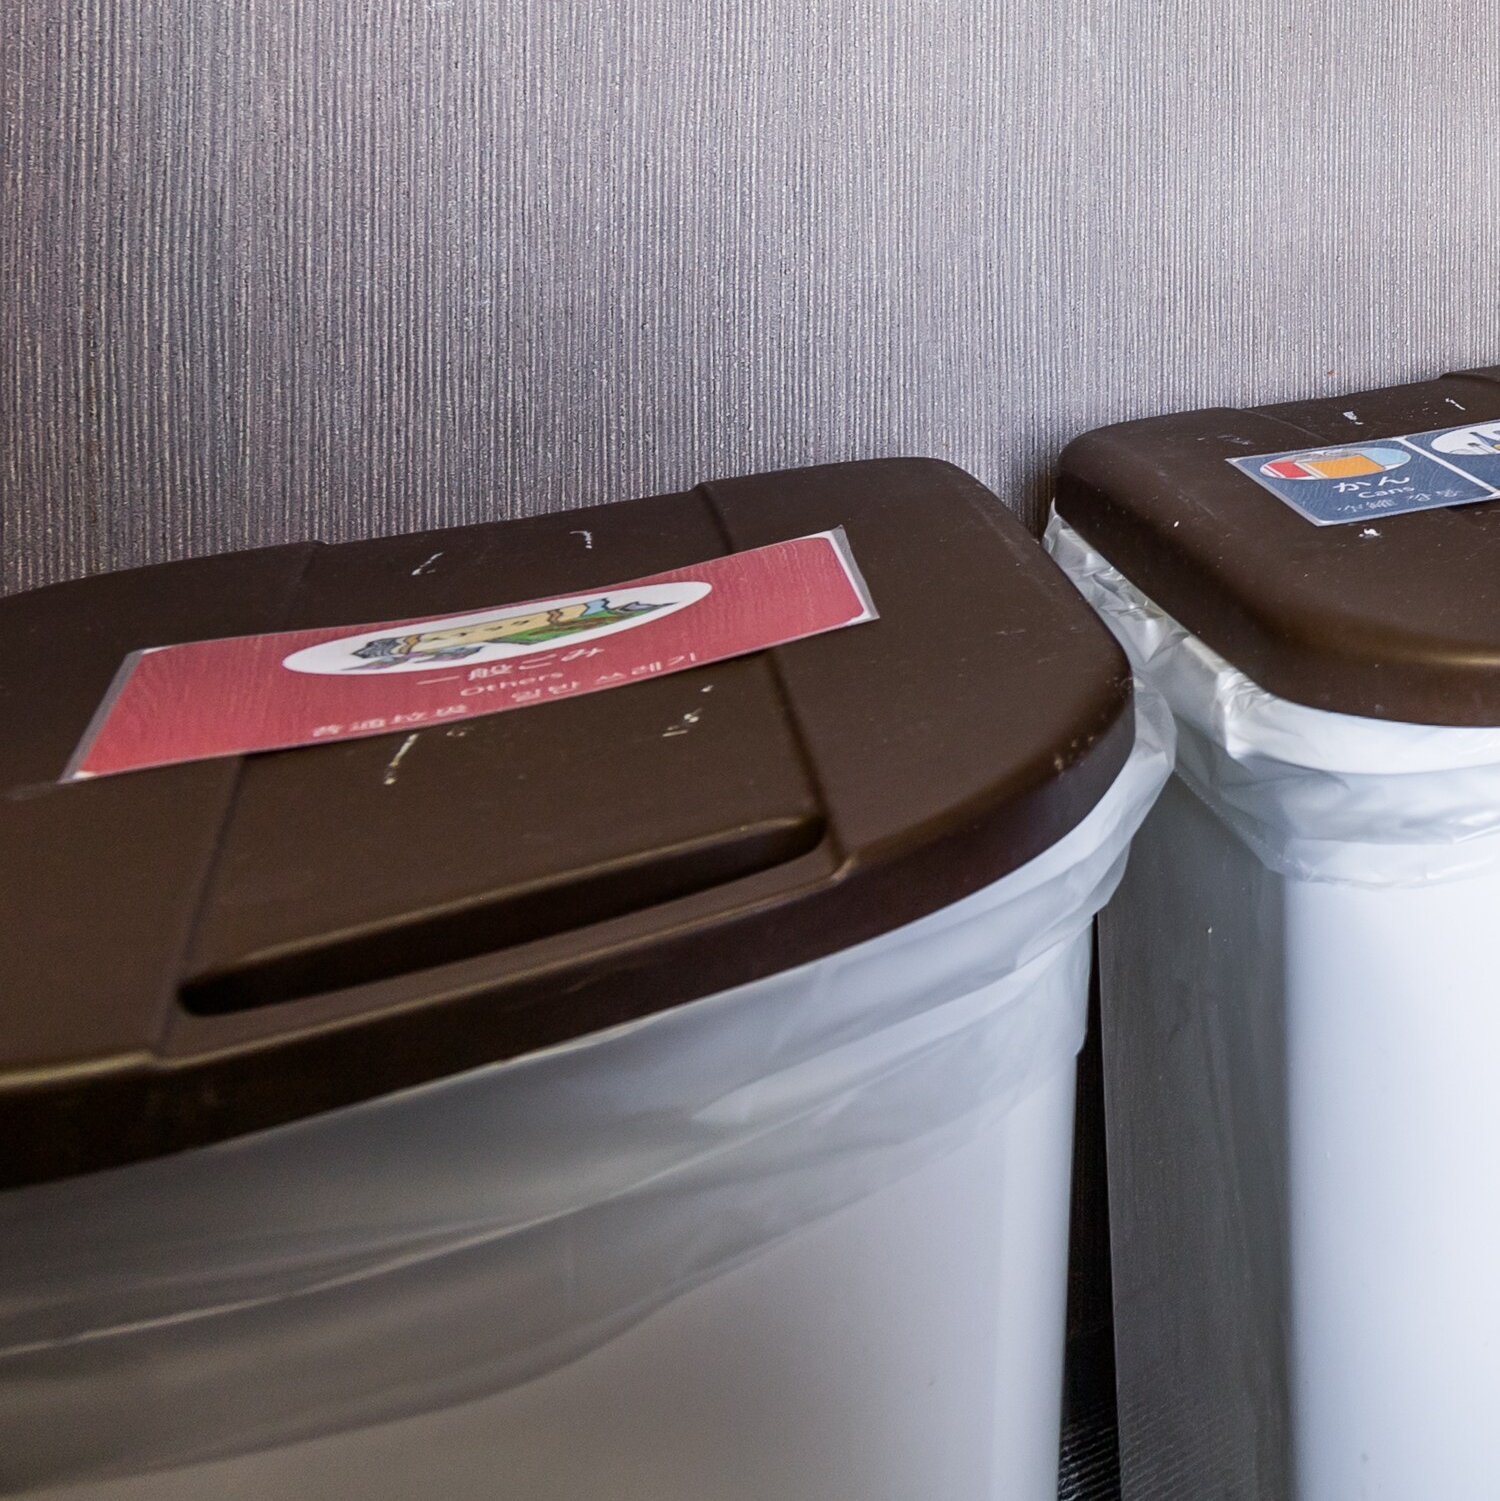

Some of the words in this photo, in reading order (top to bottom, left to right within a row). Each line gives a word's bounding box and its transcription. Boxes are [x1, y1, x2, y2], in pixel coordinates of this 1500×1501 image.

[1333, 475, 1410, 493] かん
[1358, 486, 1415, 499] Cans
[416, 647, 605, 686] 一般ごみ
[459, 672, 564, 697] Others
